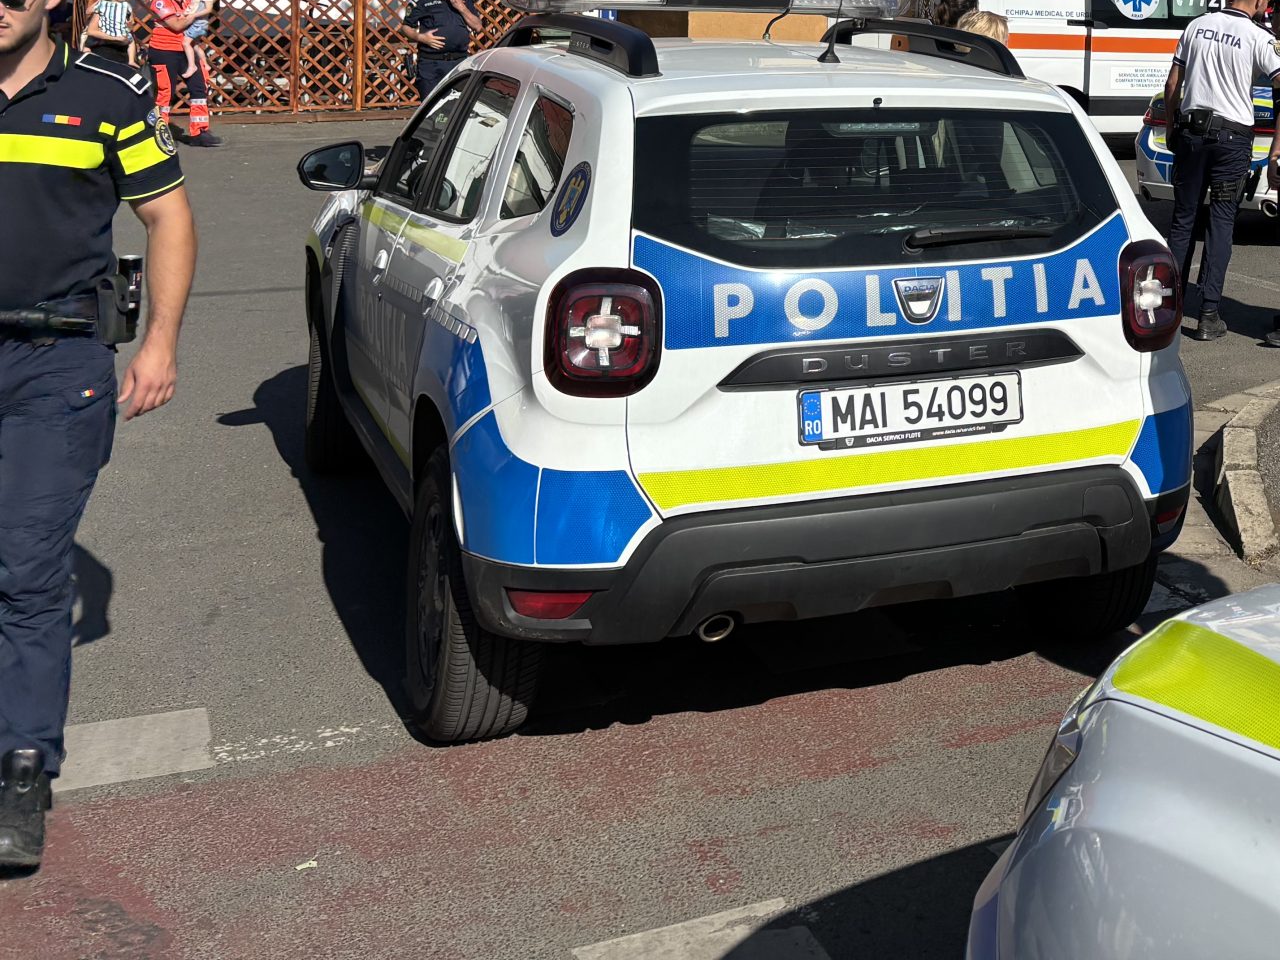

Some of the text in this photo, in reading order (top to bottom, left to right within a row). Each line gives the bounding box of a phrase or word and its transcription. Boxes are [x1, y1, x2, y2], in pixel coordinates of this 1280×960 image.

[1195, 28, 1242, 50] POLITIA
[713, 258, 1106, 338] POLITIA
[904, 284, 936, 292] DACIA
[802, 341, 1027, 374] DUSTER
[831, 381, 1009, 433] MAI 54099
[804, 419, 822, 436] RO
[866, 436, 883, 444] DACIA
